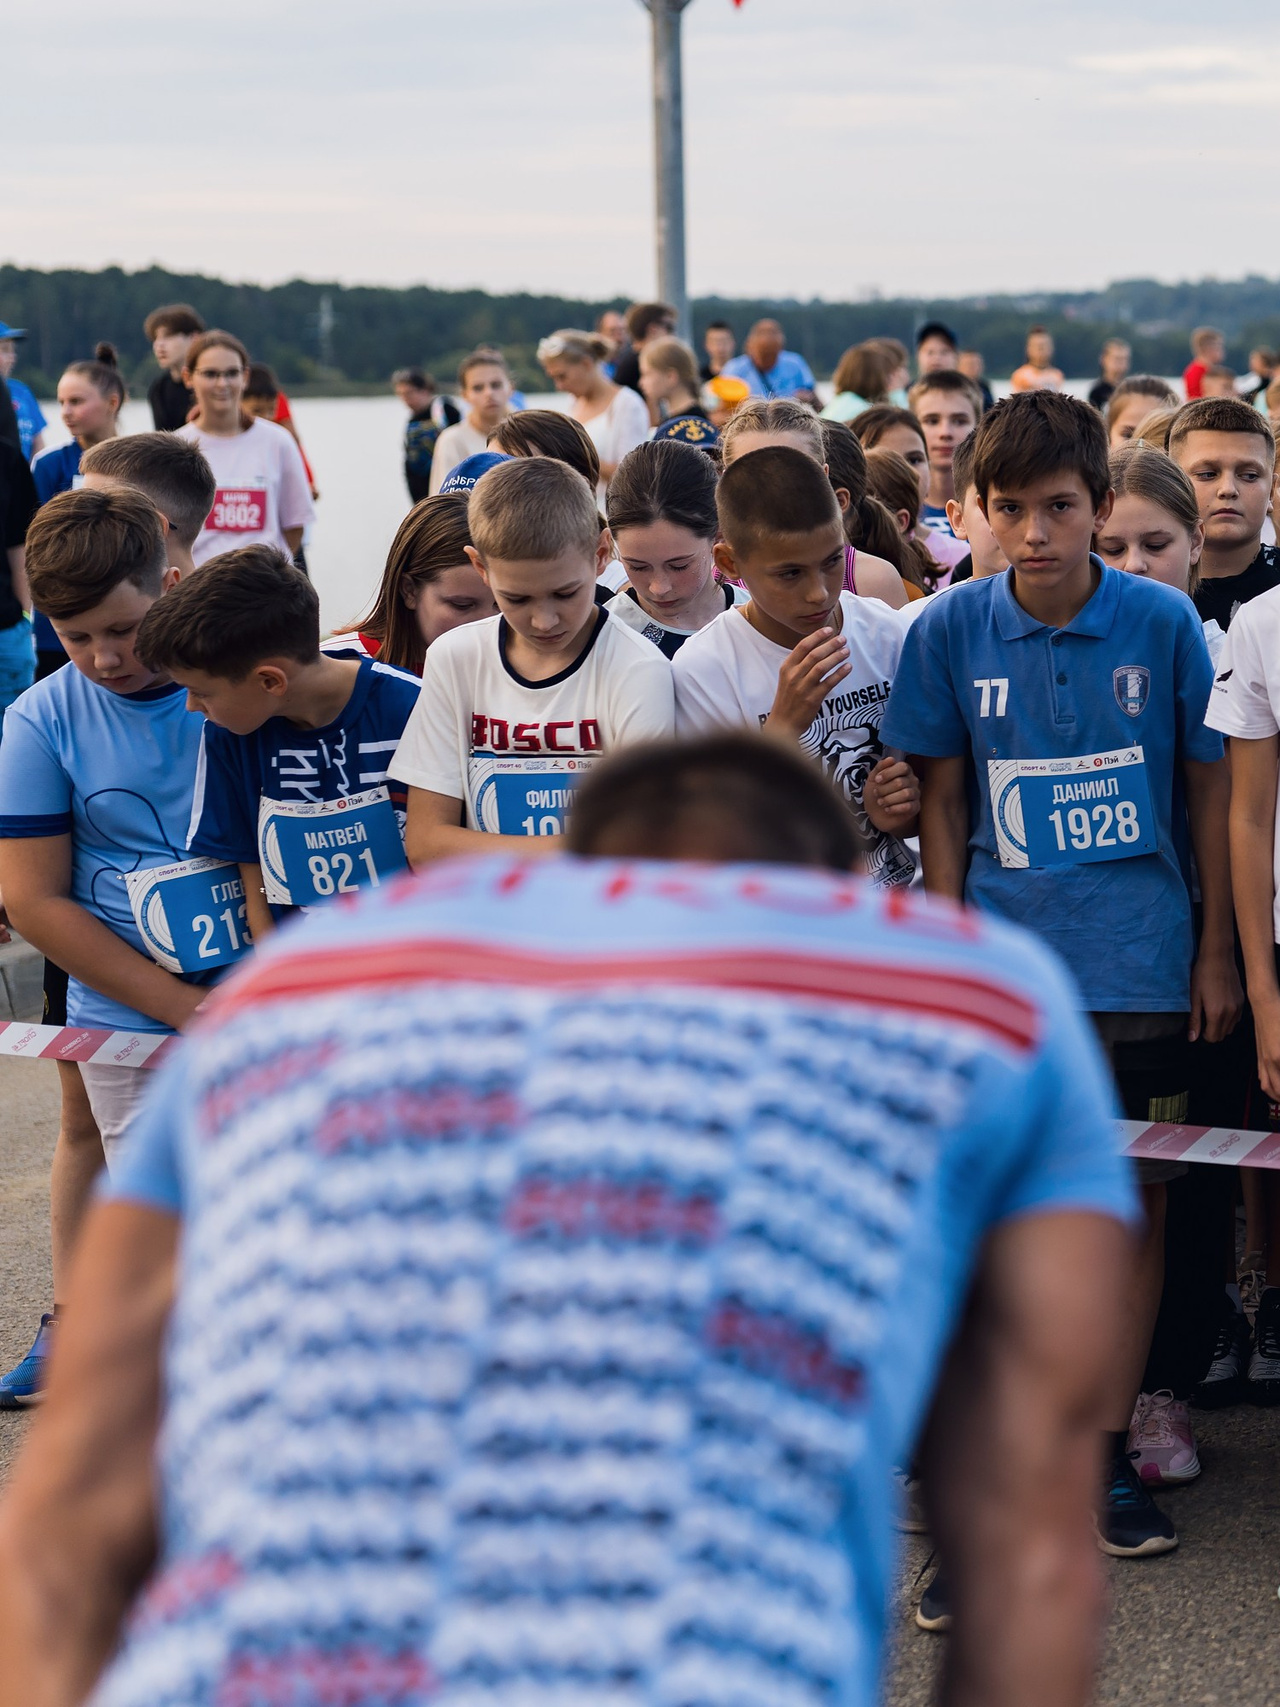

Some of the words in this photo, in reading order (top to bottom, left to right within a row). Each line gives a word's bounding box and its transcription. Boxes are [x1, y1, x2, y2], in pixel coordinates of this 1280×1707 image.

[214, 503, 260, 528] 3602
[825, 680, 891, 717] YOURSELF
[973, 678, 1009, 718] 77
[472, 714, 602, 751] BOSCO
[1104, 756, 1119, 765] Пэй
[348, 796, 363, 806] Пэй
[1052, 778, 1119, 804] ДАНИИЛ
[304, 822, 368, 850] МАТВЕЙ
[1048, 801, 1140, 850] 1928
[308, 848, 380, 896] 821
[883, 864, 915, 889] STORIES
